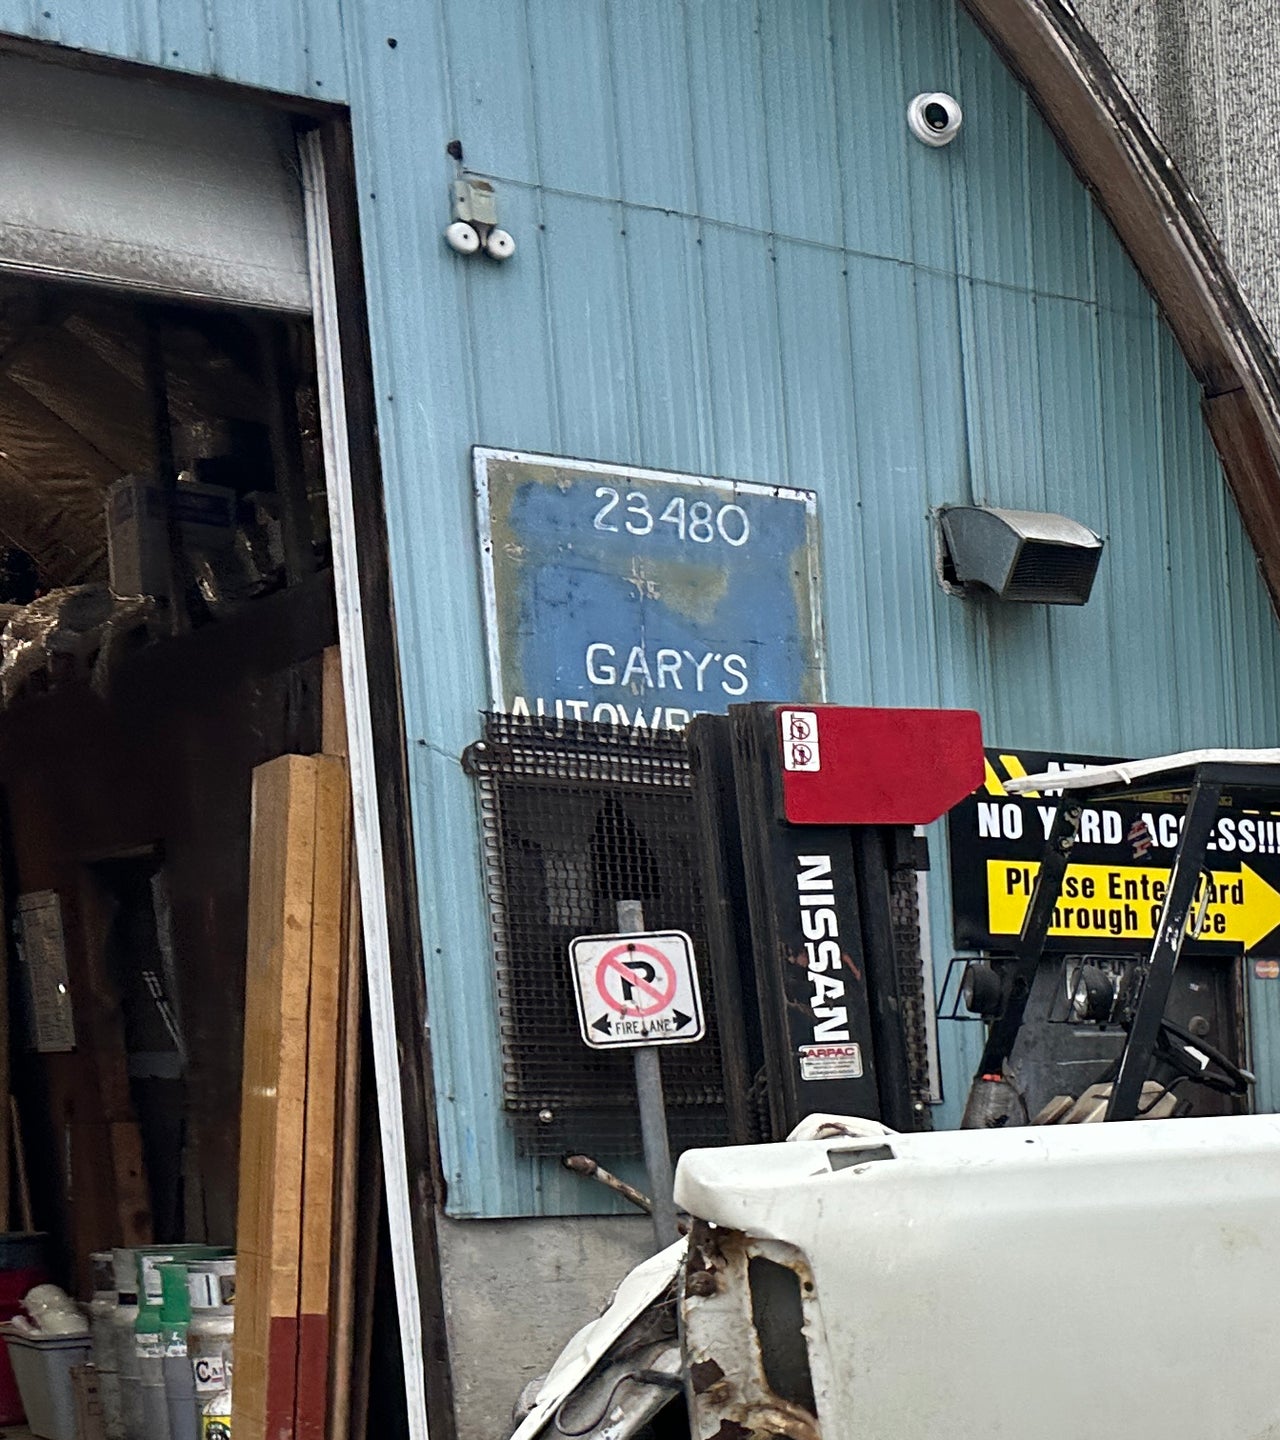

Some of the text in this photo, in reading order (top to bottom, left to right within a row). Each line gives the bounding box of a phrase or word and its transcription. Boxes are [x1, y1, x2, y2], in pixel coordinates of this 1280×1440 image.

[593, 486, 750, 546] 23480
[586, 642, 749, 696] GARY'S
[977, 802, 1024, 840] NO
[1037, 805, 1123, 845] YRD
[1006, 868, 1096, 900] Plse
[1108, 872, 1165, 900] Ente
[1049, 903, 1139, 935] hrough
[797, 854, 850, 1043] NISSAN
[614, 1020, 672, 1035] FIRE LANE
